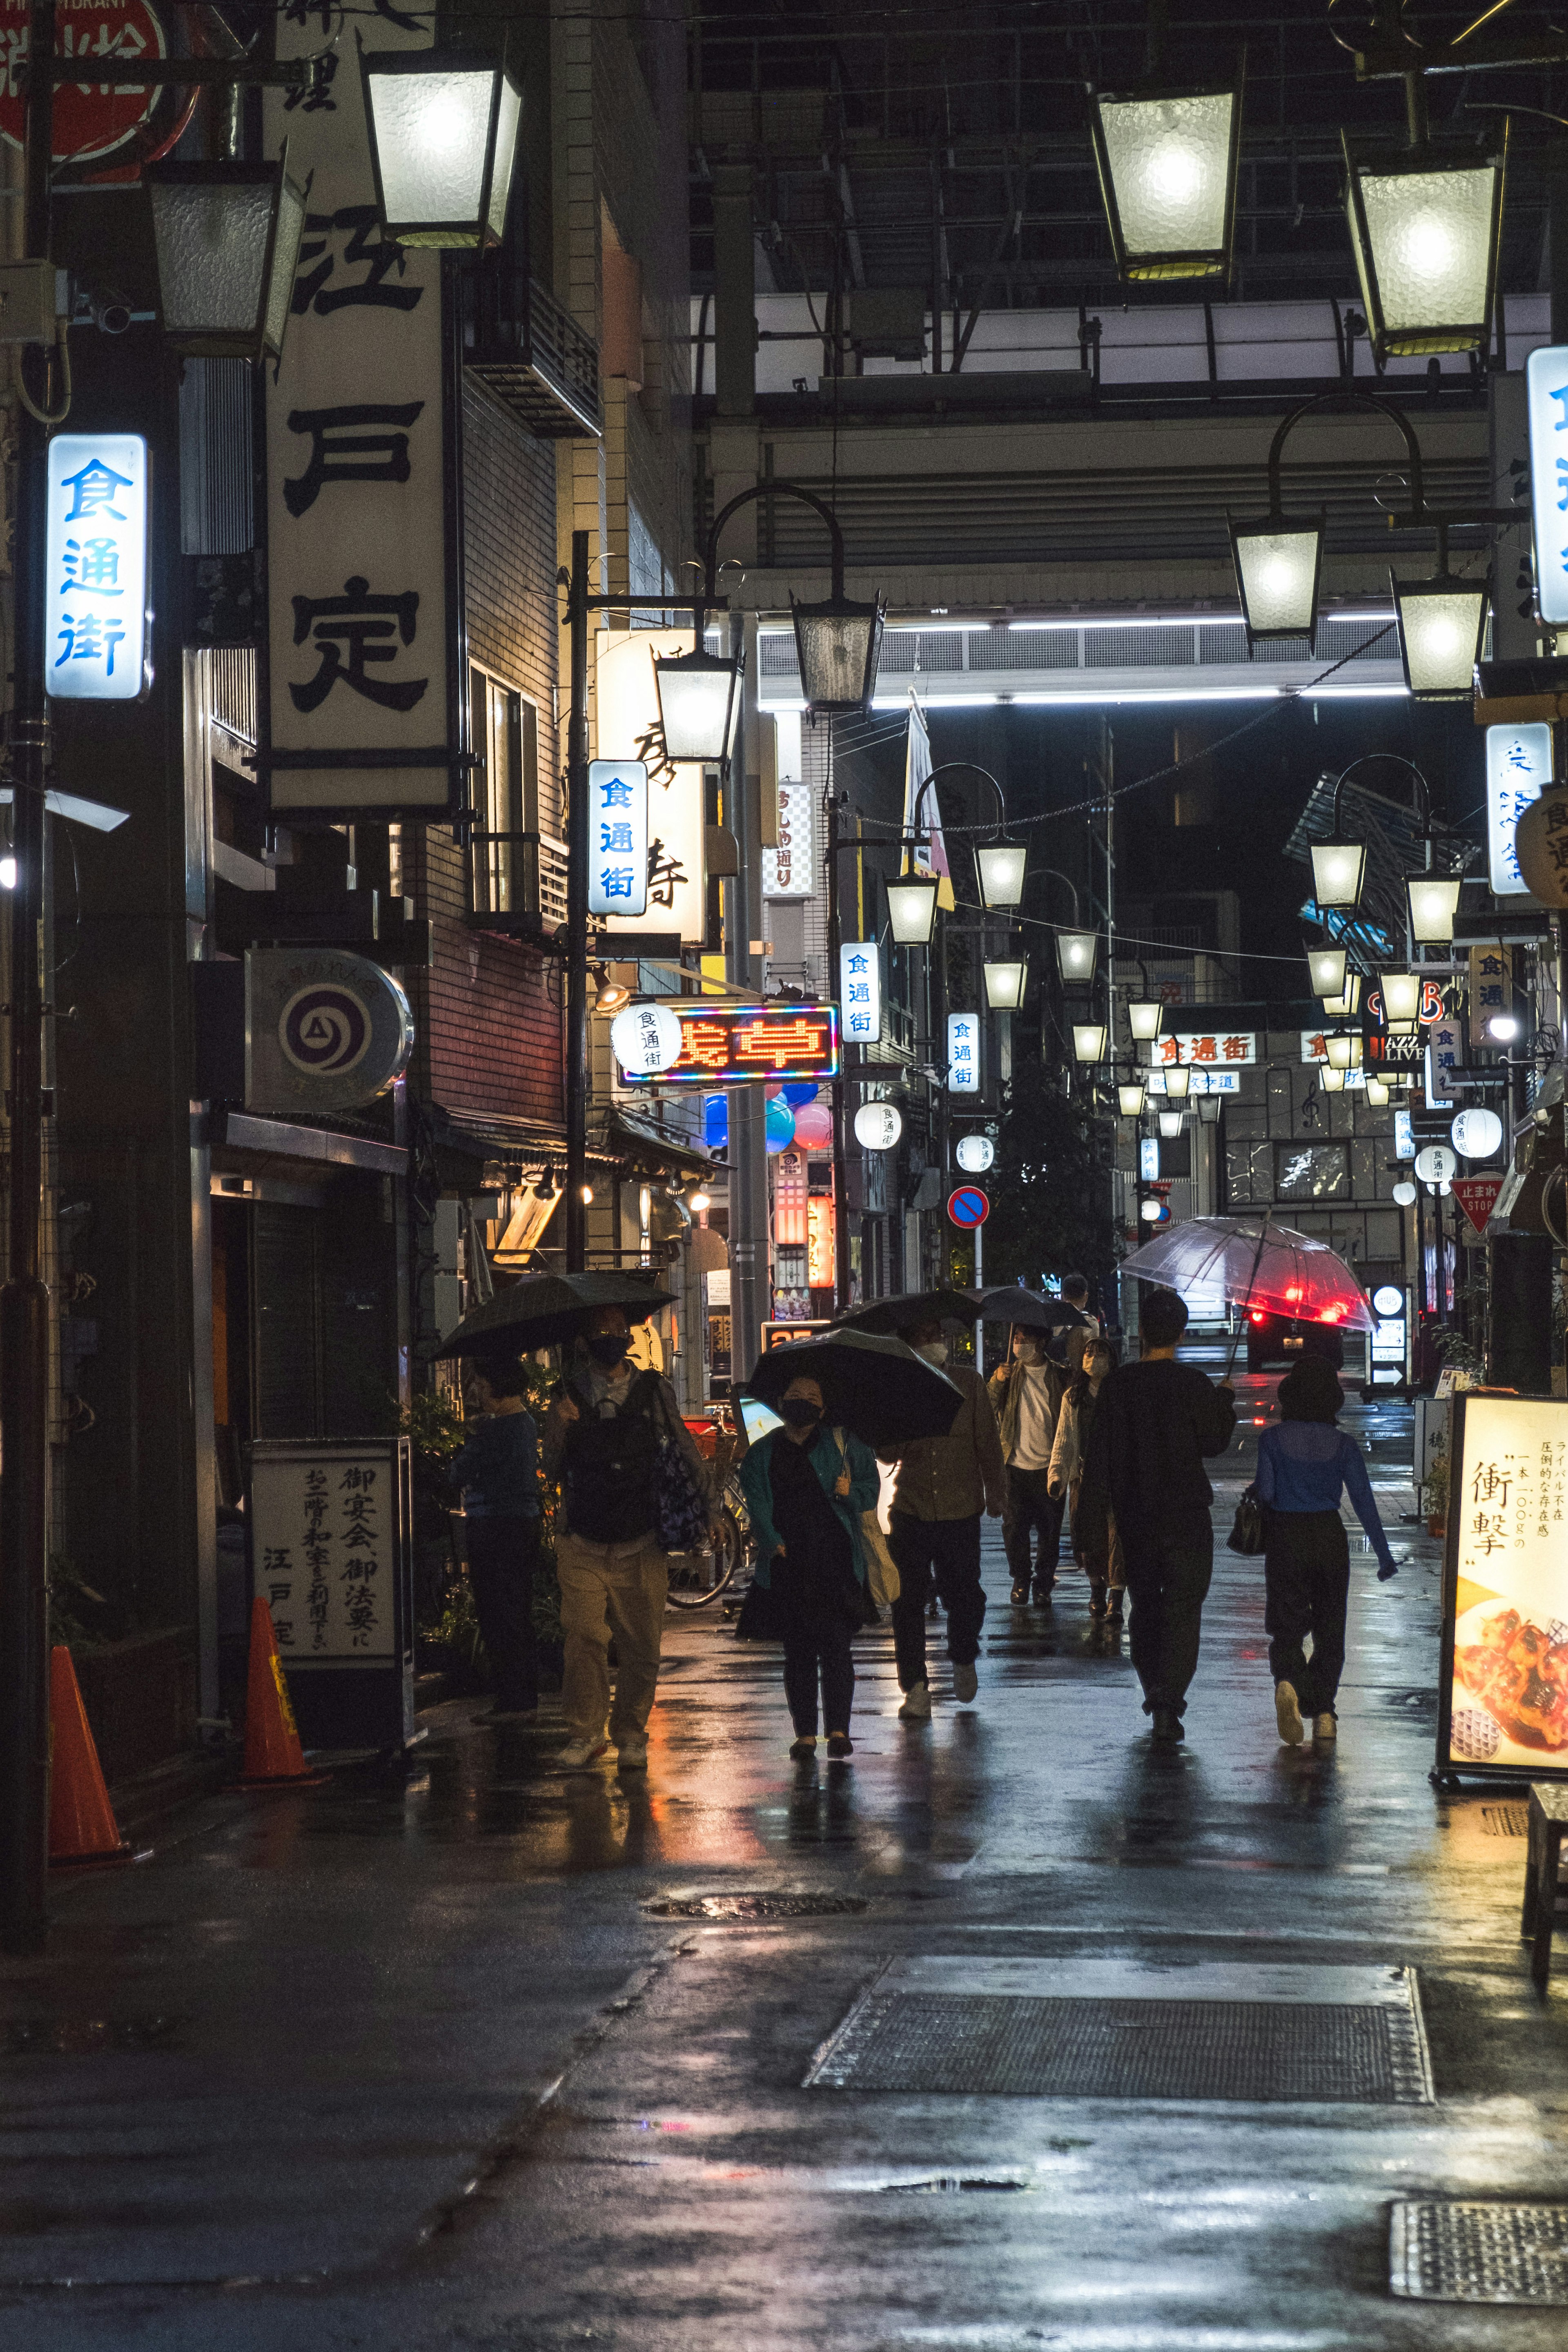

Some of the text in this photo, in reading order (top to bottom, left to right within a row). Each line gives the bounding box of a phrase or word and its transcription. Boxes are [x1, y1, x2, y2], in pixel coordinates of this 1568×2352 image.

[55, 458, 132, 677] 食通街
[599, 777, 635, 898] 食通街
[848, 954, 871, 1033] 食通街
[637, 1011, 662, 1067] 食通街
[953, 1022, 972, 1084] 食通街
[1159, 1036, 1250, 1062] 食通街
[1385, 1048, 1424, 1061] LIVE
[882, 1108, 894, 1145] 食通街
[1399, 1116, 1411, 1154] 食通街
[1455, 1115, 1469, 1153] 食通街
[1433, 1150, 1443, 1178] 食通街
[1462, 1185, 1497, 1198] 止まれ
[1468, 1200, 1492, 1211] STOP
[1537, 1441, 1552, 1538] 圧倒的な存在感
[1553, 1441, 1566, 1521] ライバル不在
